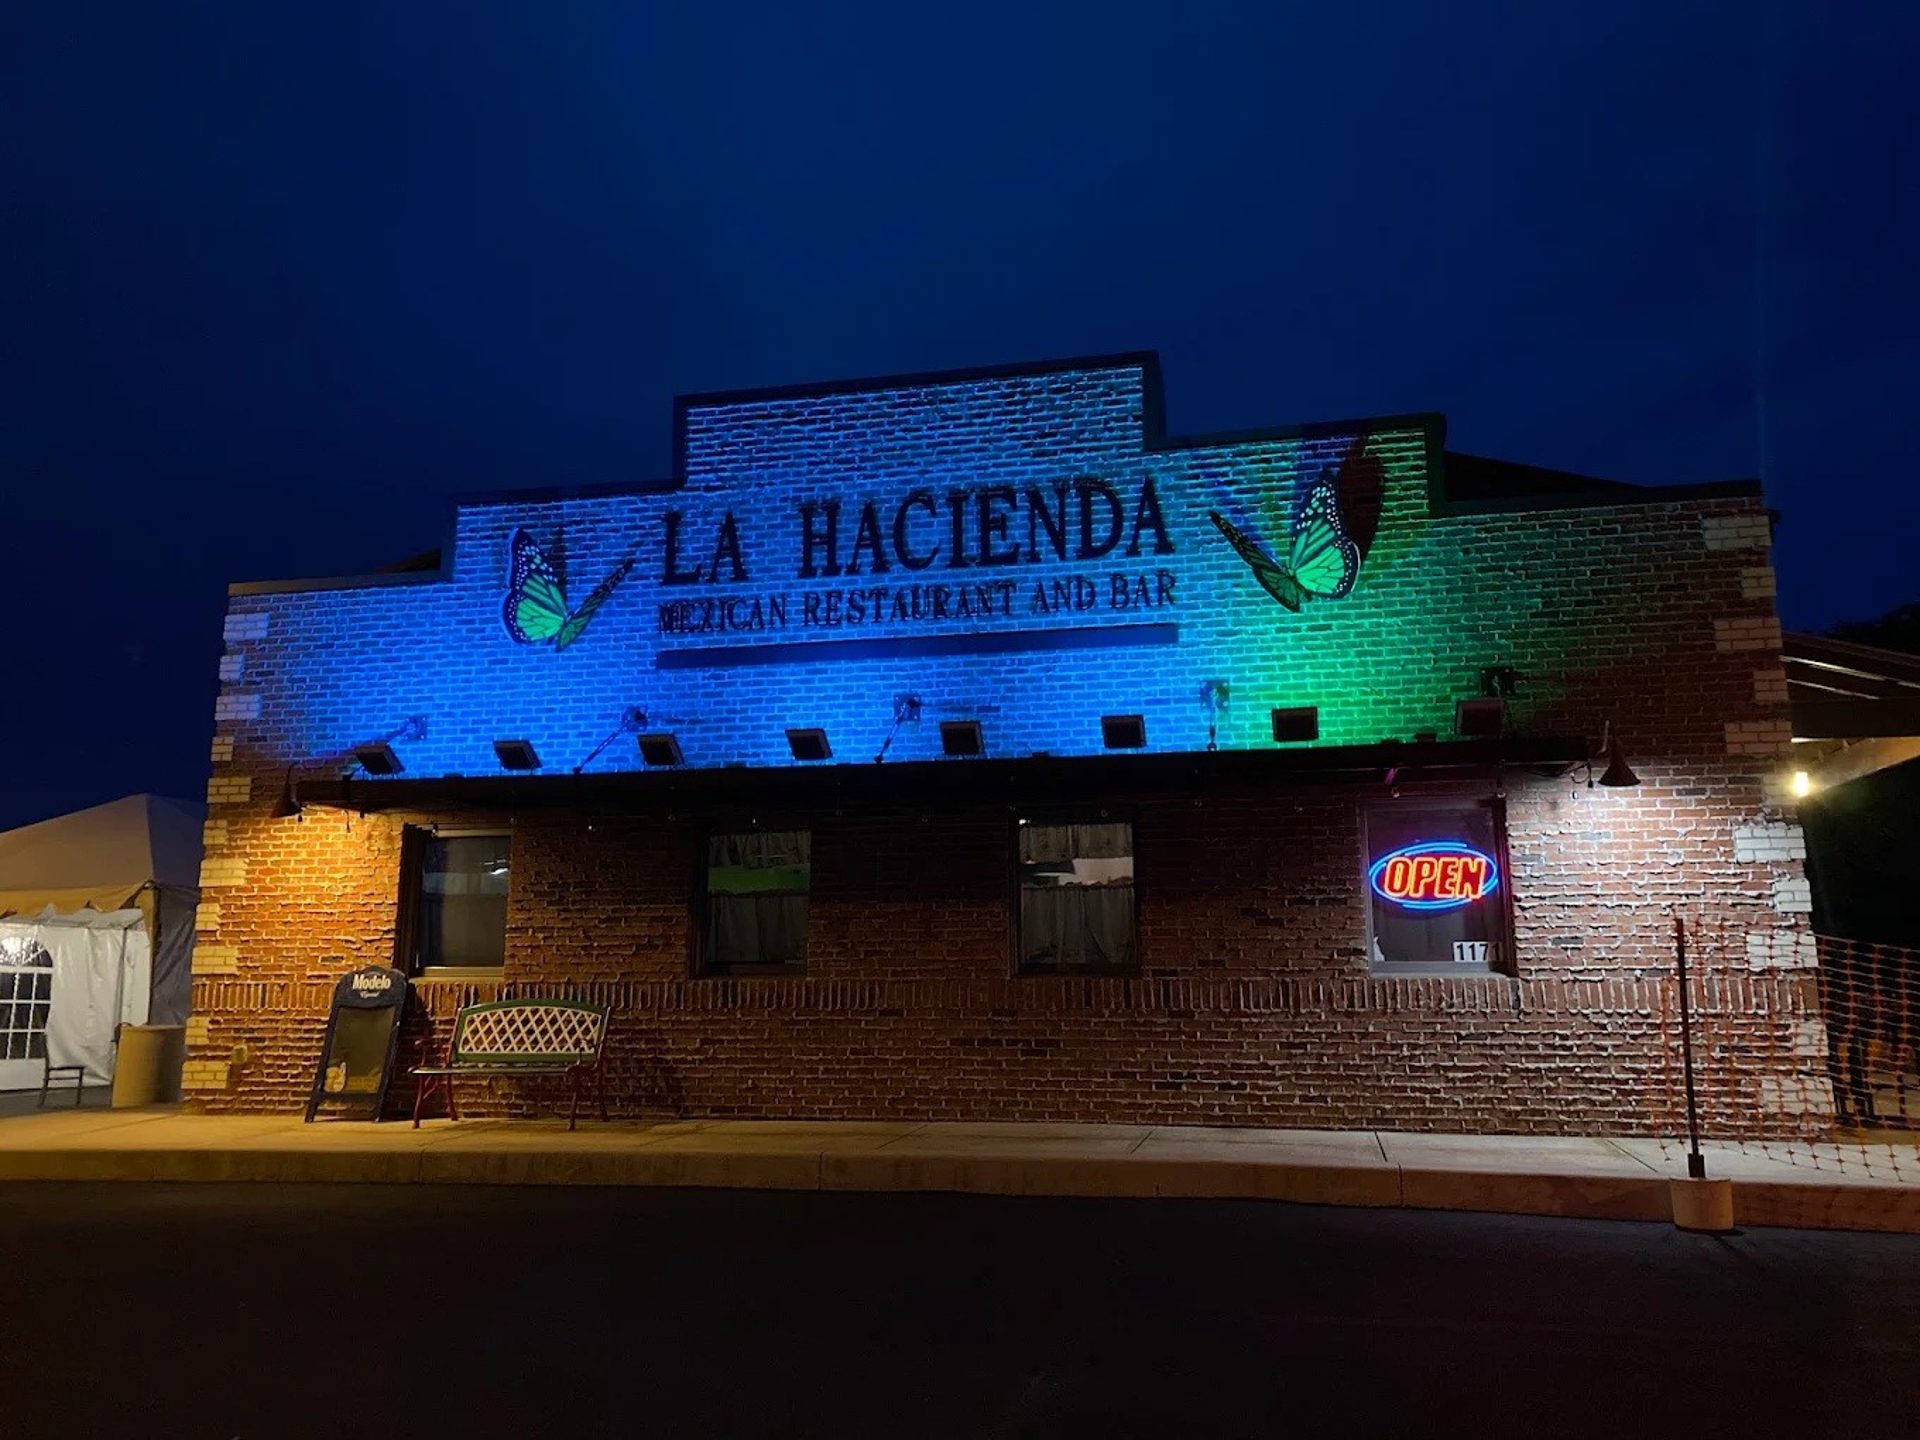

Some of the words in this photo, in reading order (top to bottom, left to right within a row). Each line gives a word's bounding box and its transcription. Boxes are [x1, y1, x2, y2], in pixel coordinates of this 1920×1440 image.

[660, 511, 748, 586] LA
[798, 475, 1176, 579] HACIENDA
[658, 591, 787, 633] MEXICAN
[802, 582, 1017, 626] RESTAURANT
[1032, 573, 1096, 614] AND
[1109, 569, 1177, 610] BAR
[1384, 857, 1486, 899] OPEN
[353, 973, 392, 990] Modelo
